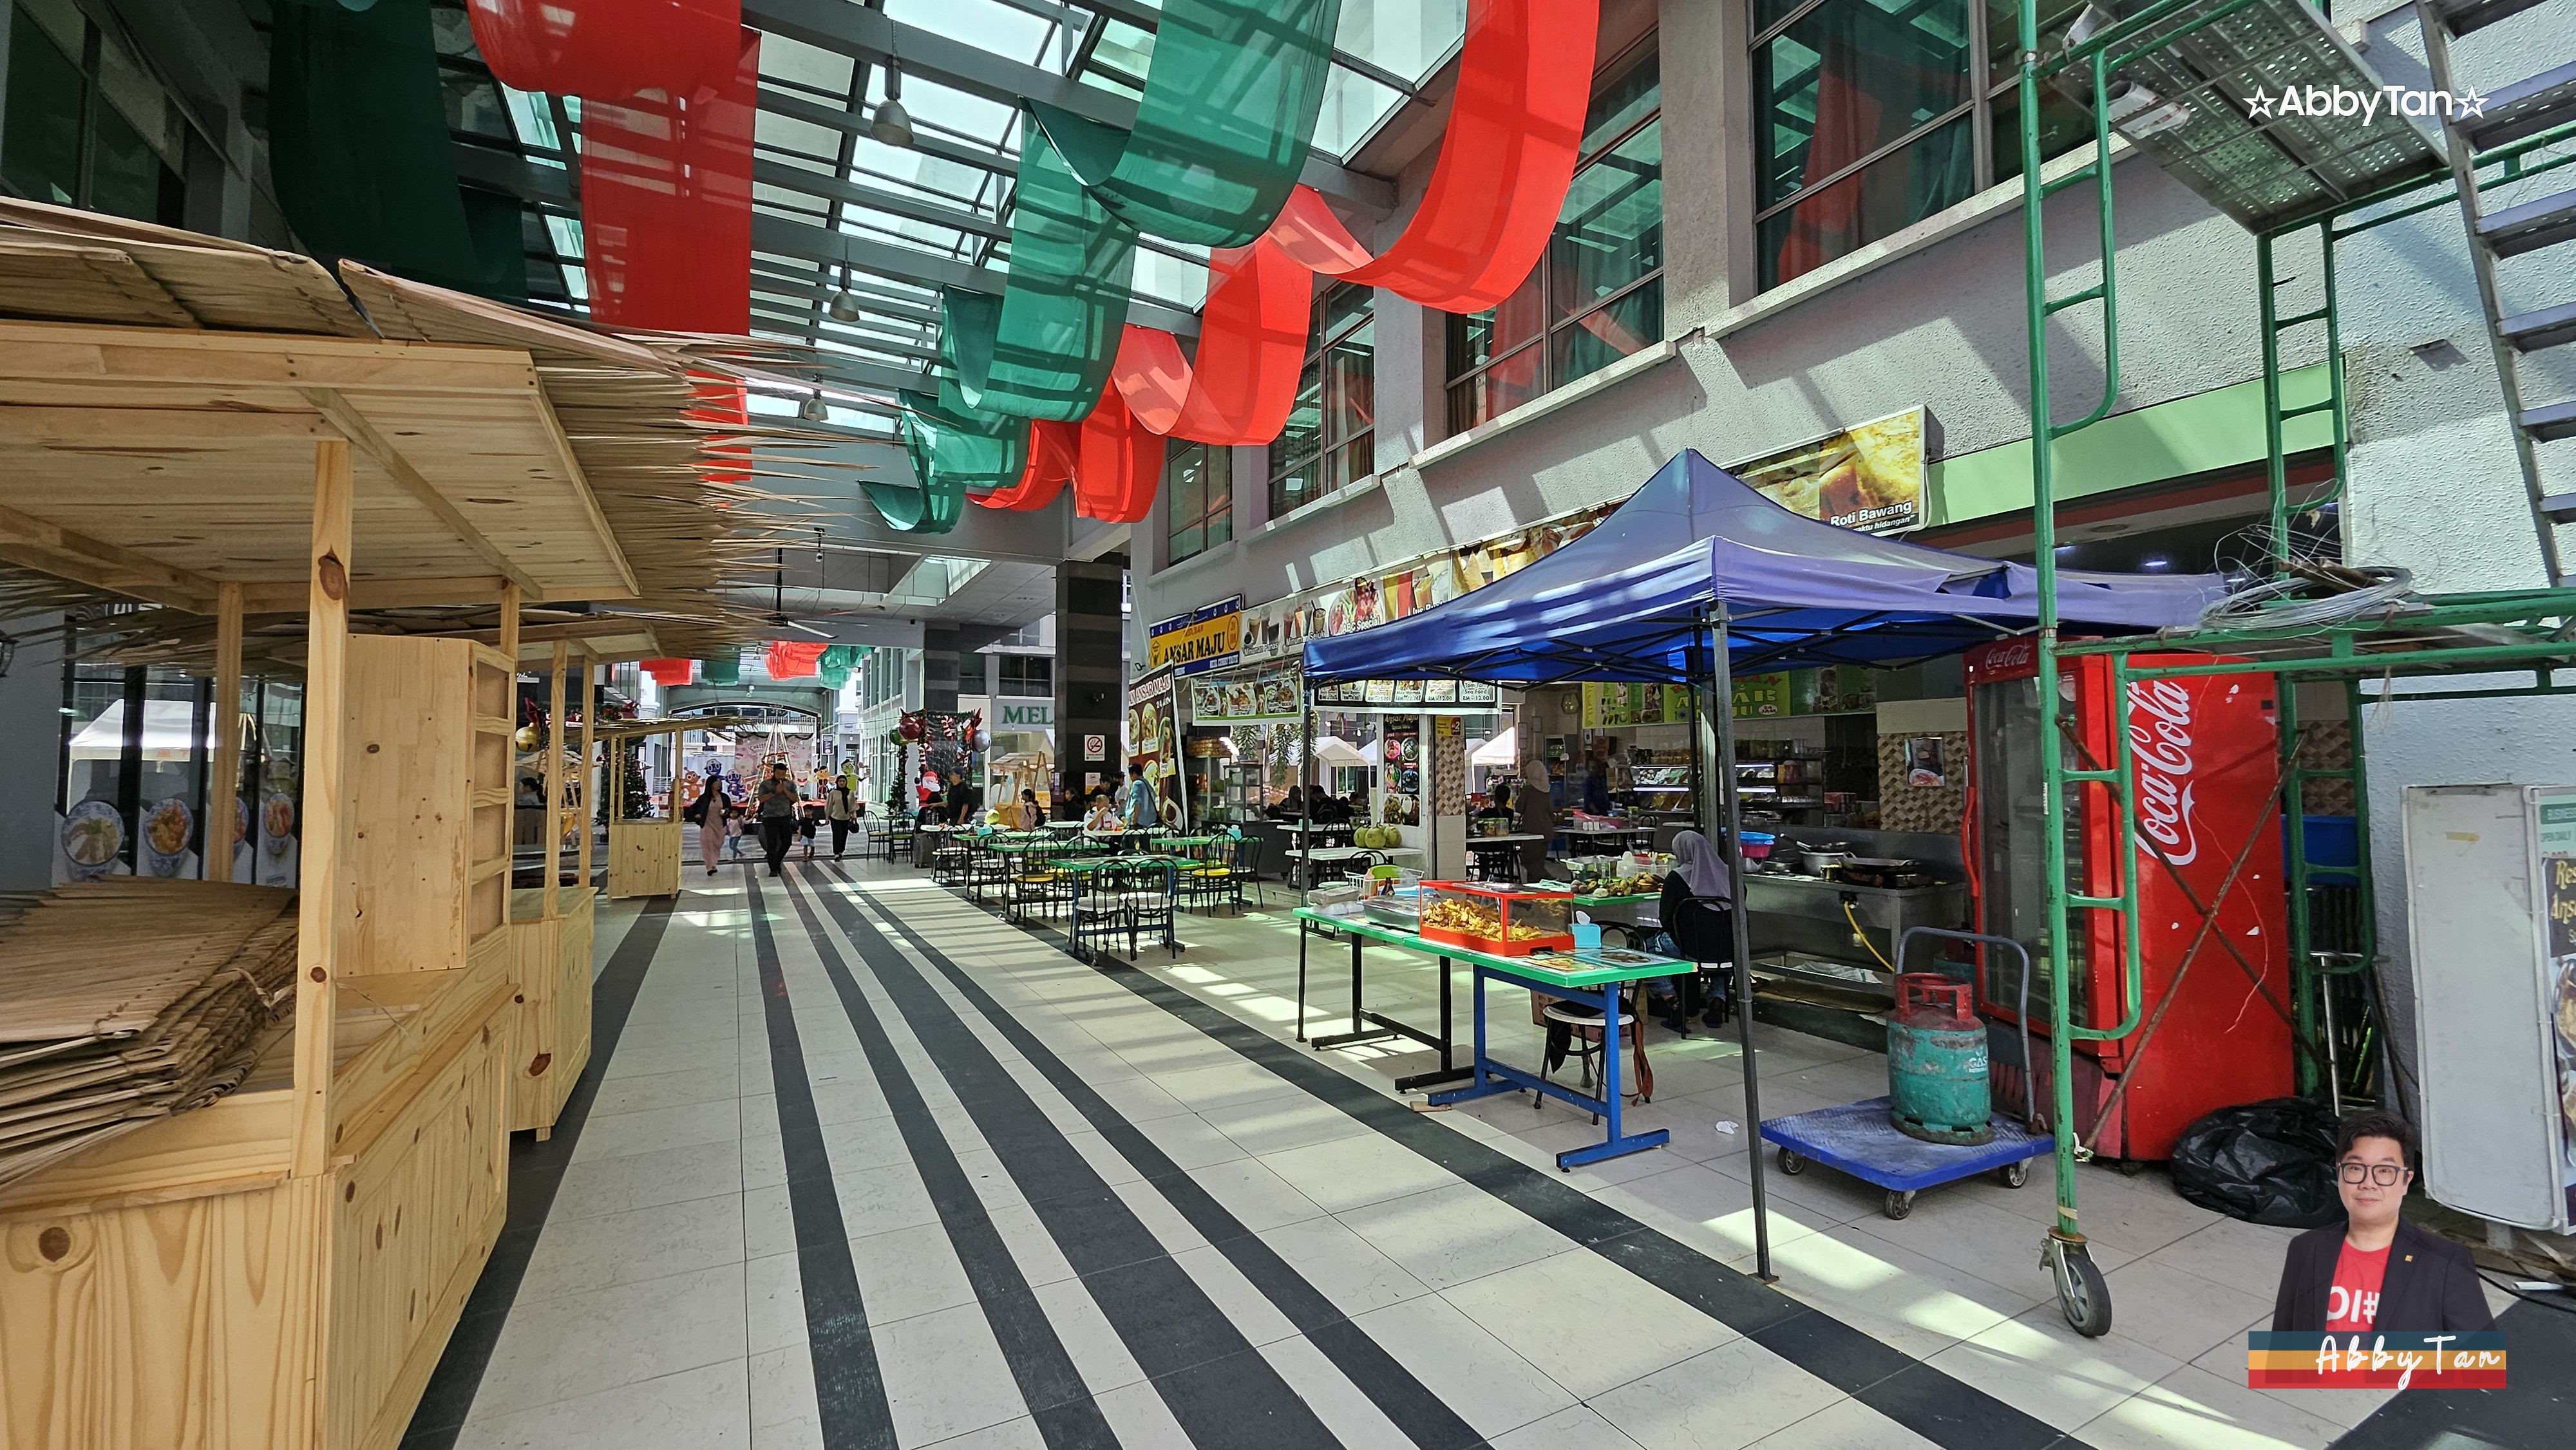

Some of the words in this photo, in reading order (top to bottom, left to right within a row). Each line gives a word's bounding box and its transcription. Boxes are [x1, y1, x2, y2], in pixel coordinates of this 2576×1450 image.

[1830, 513, 1856, 527] Roti
[1859, 501, 1912, 520] Bawang
[1342, 622, 1356, 634] ABC
[1356, 616, 1381, 630] Special
[1163, 640, 1194, 664] ANSAR
[1196, 632, 1226, 659] MAJU
[1244, 645, 1264, 656] Minuman
[1264, 643, 1278, 652] Panas
[1286, 635, 1309, 646] Minuman
[1136, 680, 1153, 704] ANSAR
[1385, 714, 1401, 724] Ansar
[2128, 680, 2197, 866] Coca-Cola
